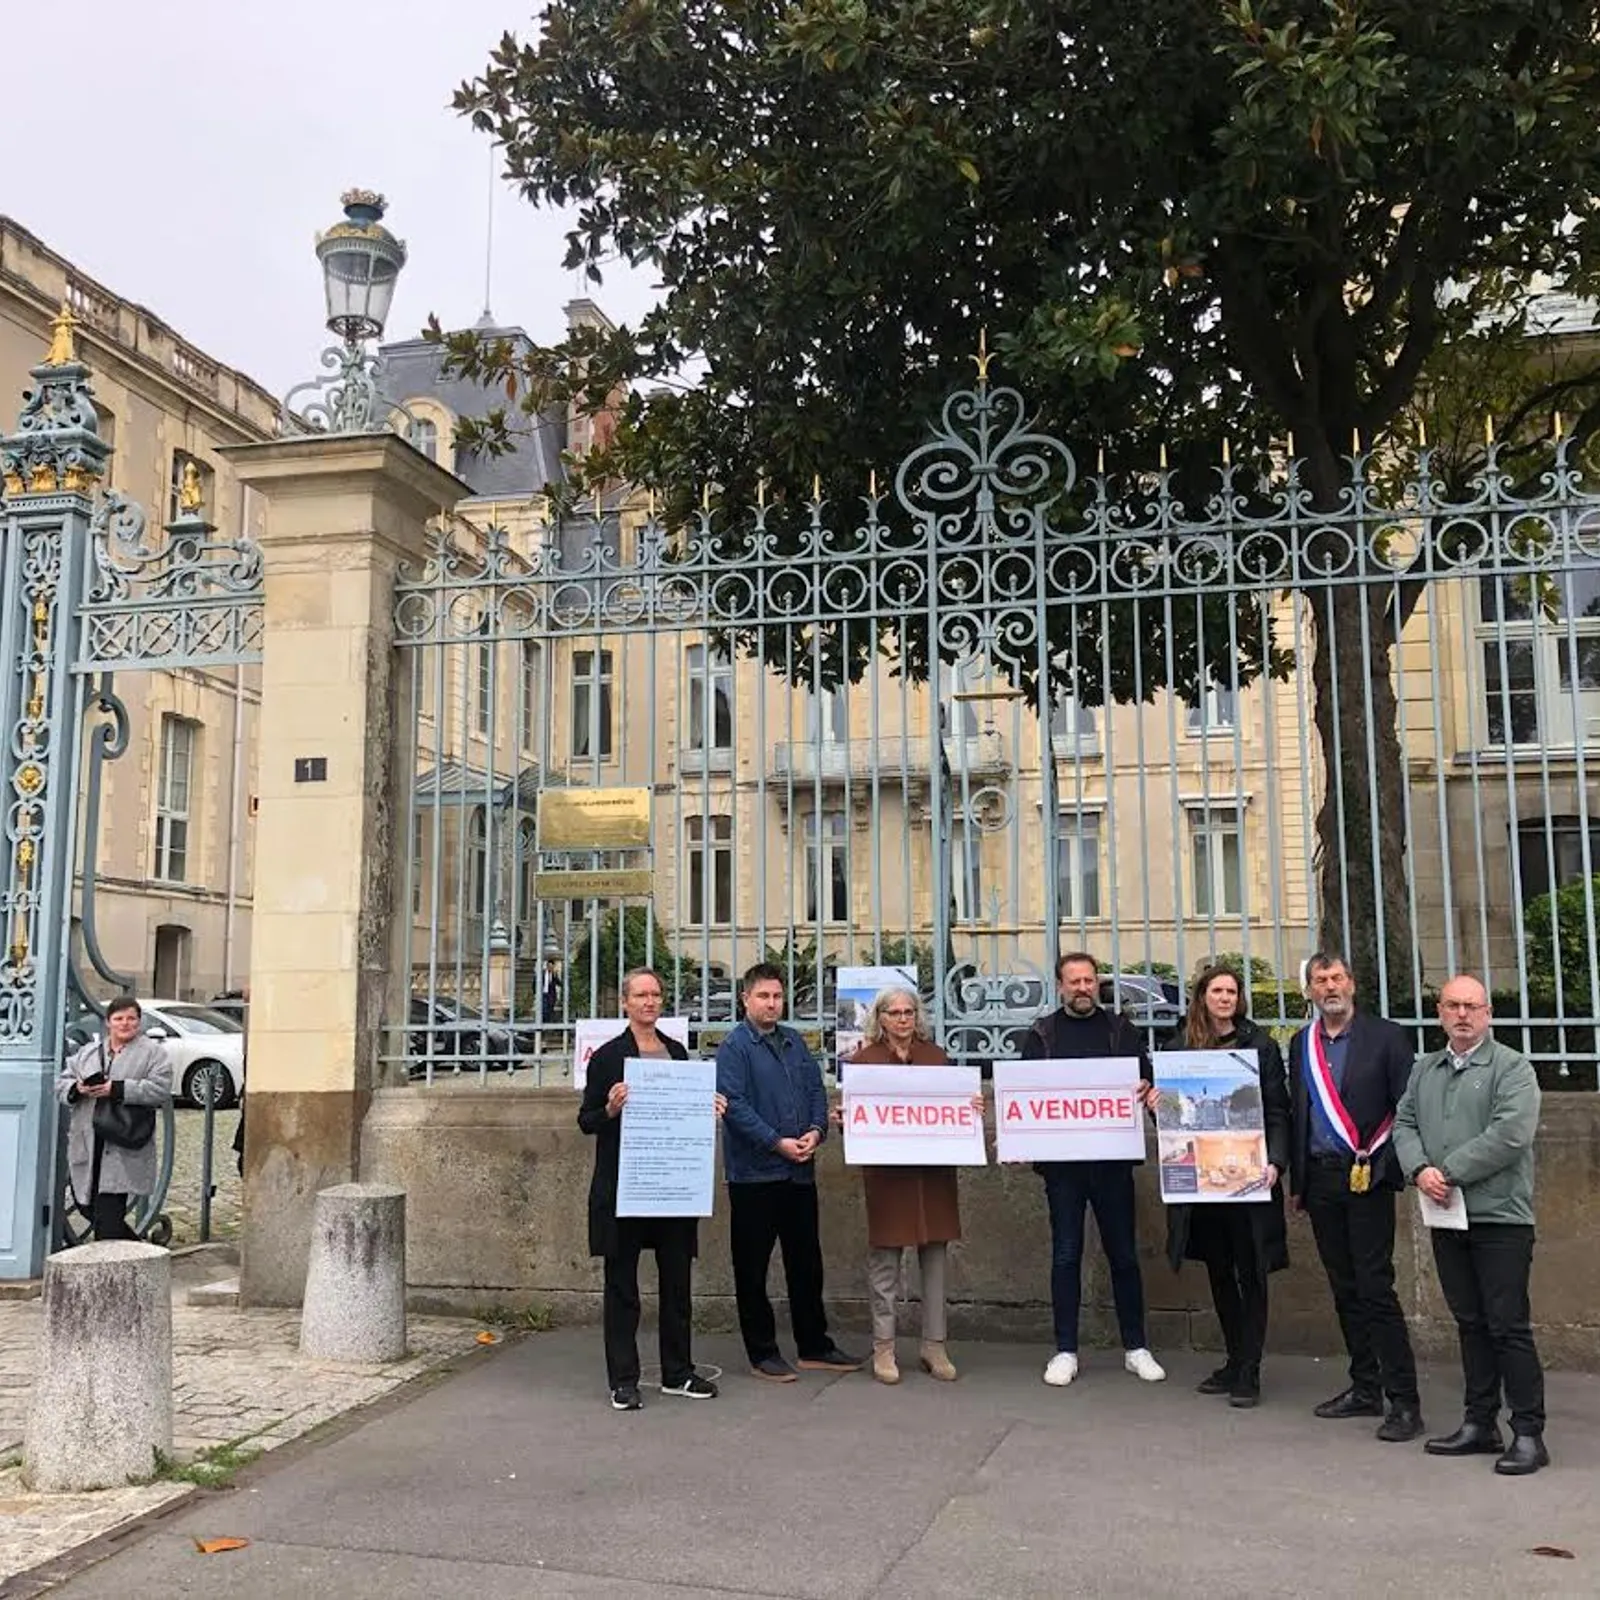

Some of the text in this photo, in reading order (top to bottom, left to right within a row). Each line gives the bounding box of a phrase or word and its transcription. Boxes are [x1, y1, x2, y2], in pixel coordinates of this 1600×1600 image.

[304, 760, 312, 779] 1
[853, 1105, 973, 1126] A VENDRE
[1007, 1098, 1132, 1120] A VENDRE
